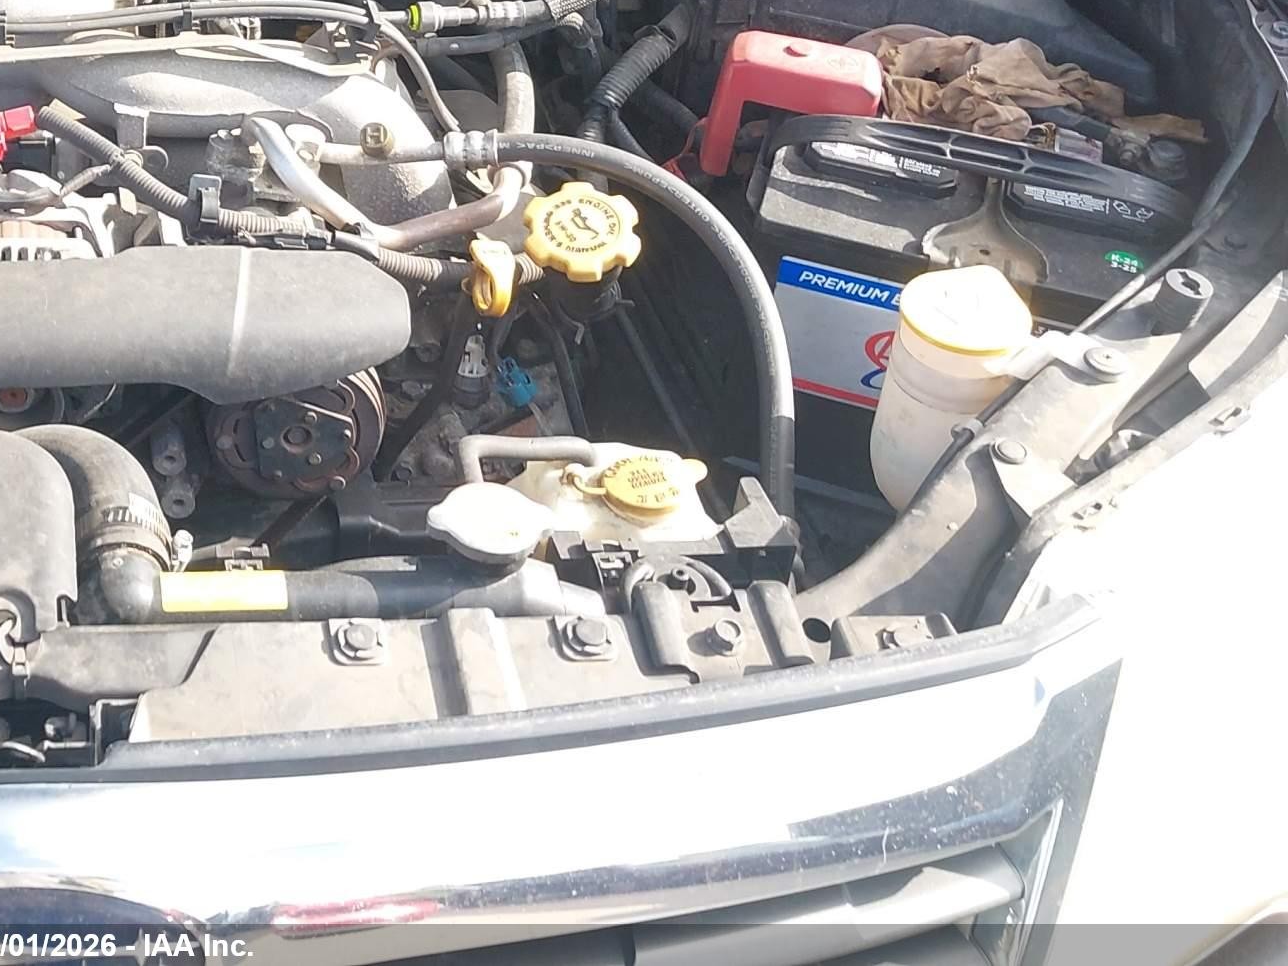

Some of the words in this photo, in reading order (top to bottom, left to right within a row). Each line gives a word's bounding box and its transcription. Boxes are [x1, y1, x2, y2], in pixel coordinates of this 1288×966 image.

[578, 198, 615, 220] ENGINE
[608, 223, 617, 236] OIL
[798, 270, 891, 303] PREMIUM
